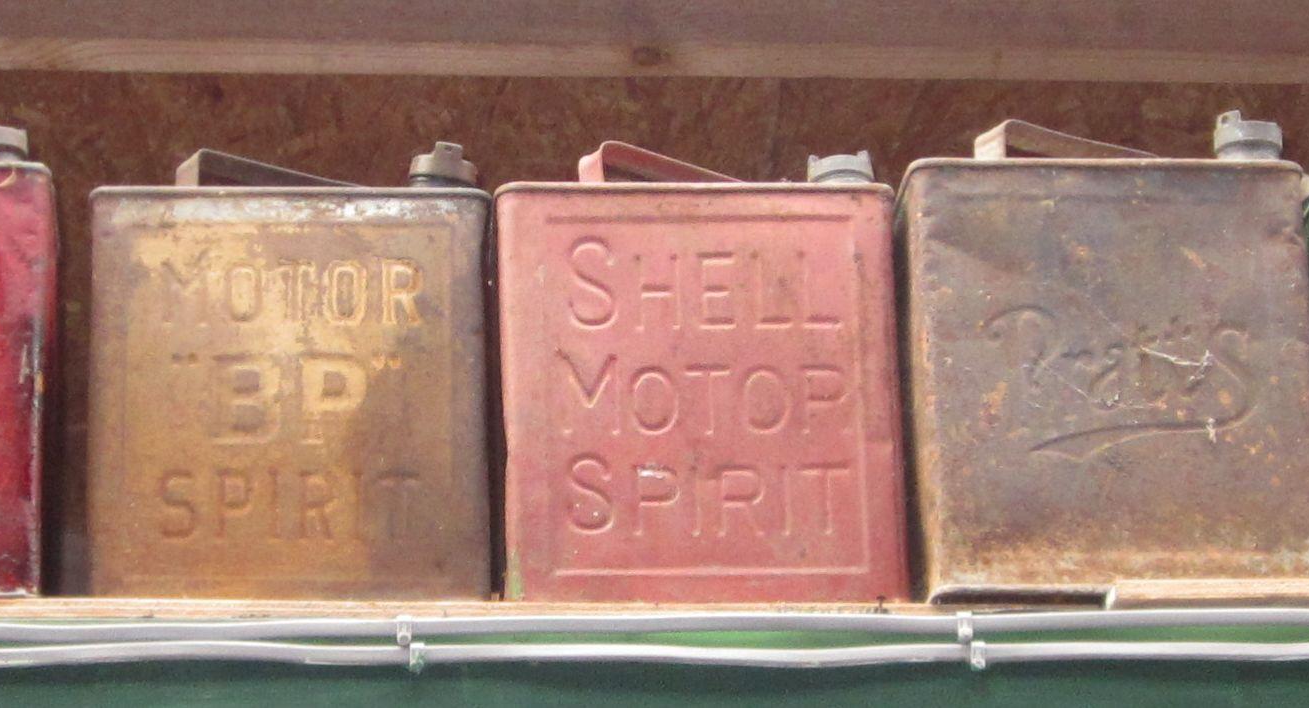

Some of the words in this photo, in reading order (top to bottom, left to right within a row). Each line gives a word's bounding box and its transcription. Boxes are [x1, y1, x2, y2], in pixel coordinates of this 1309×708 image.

[157, 252, 427, 327] MOTOR
[568, 236, 845, 331] SHELL
[158, 466, 422, 541] SPIRIT
[567, 452, 851, 536] SPIRIT
